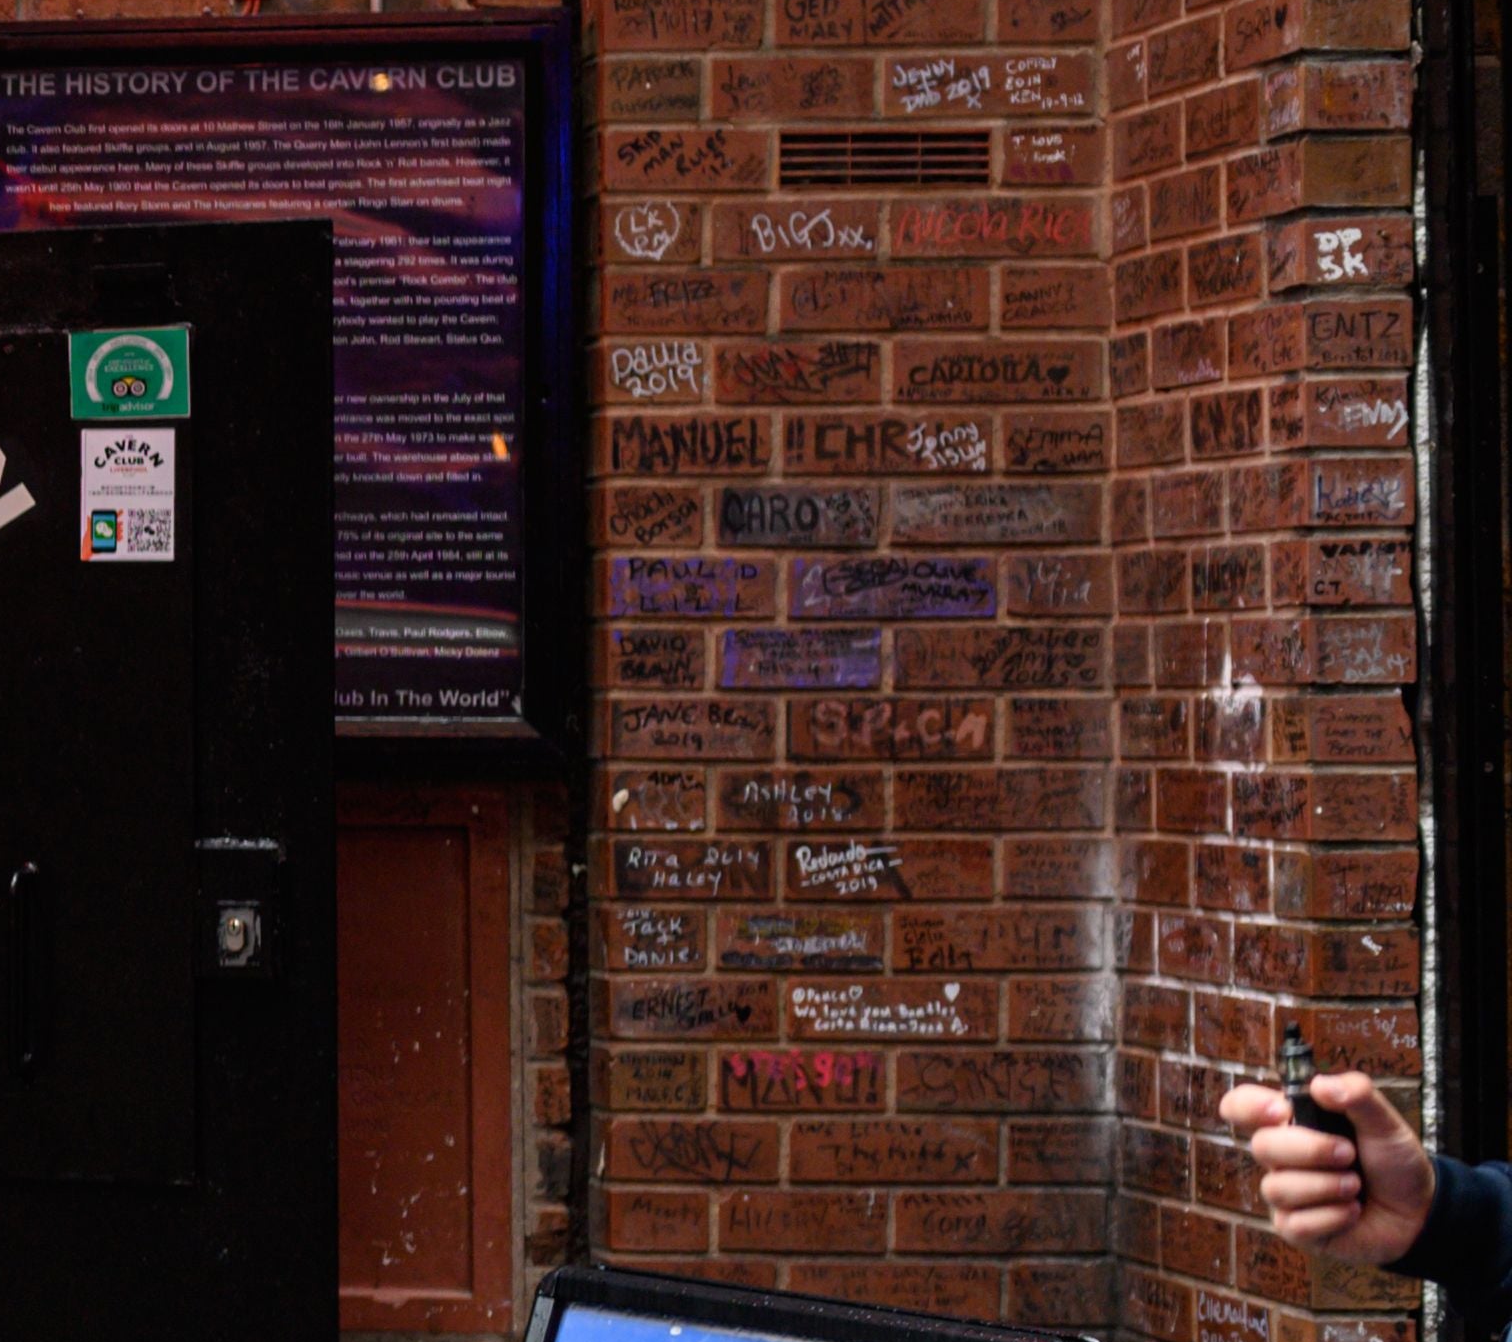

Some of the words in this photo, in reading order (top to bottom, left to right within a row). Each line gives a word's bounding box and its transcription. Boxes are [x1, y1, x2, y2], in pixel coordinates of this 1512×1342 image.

[1, 73, 57, 96] THE
[65, 71, 187, 96] HISTORY
[196, 70, 235, 94] OF
[243, 69, 300, 92] THE
[436, 66, 517, 89] CLUB
